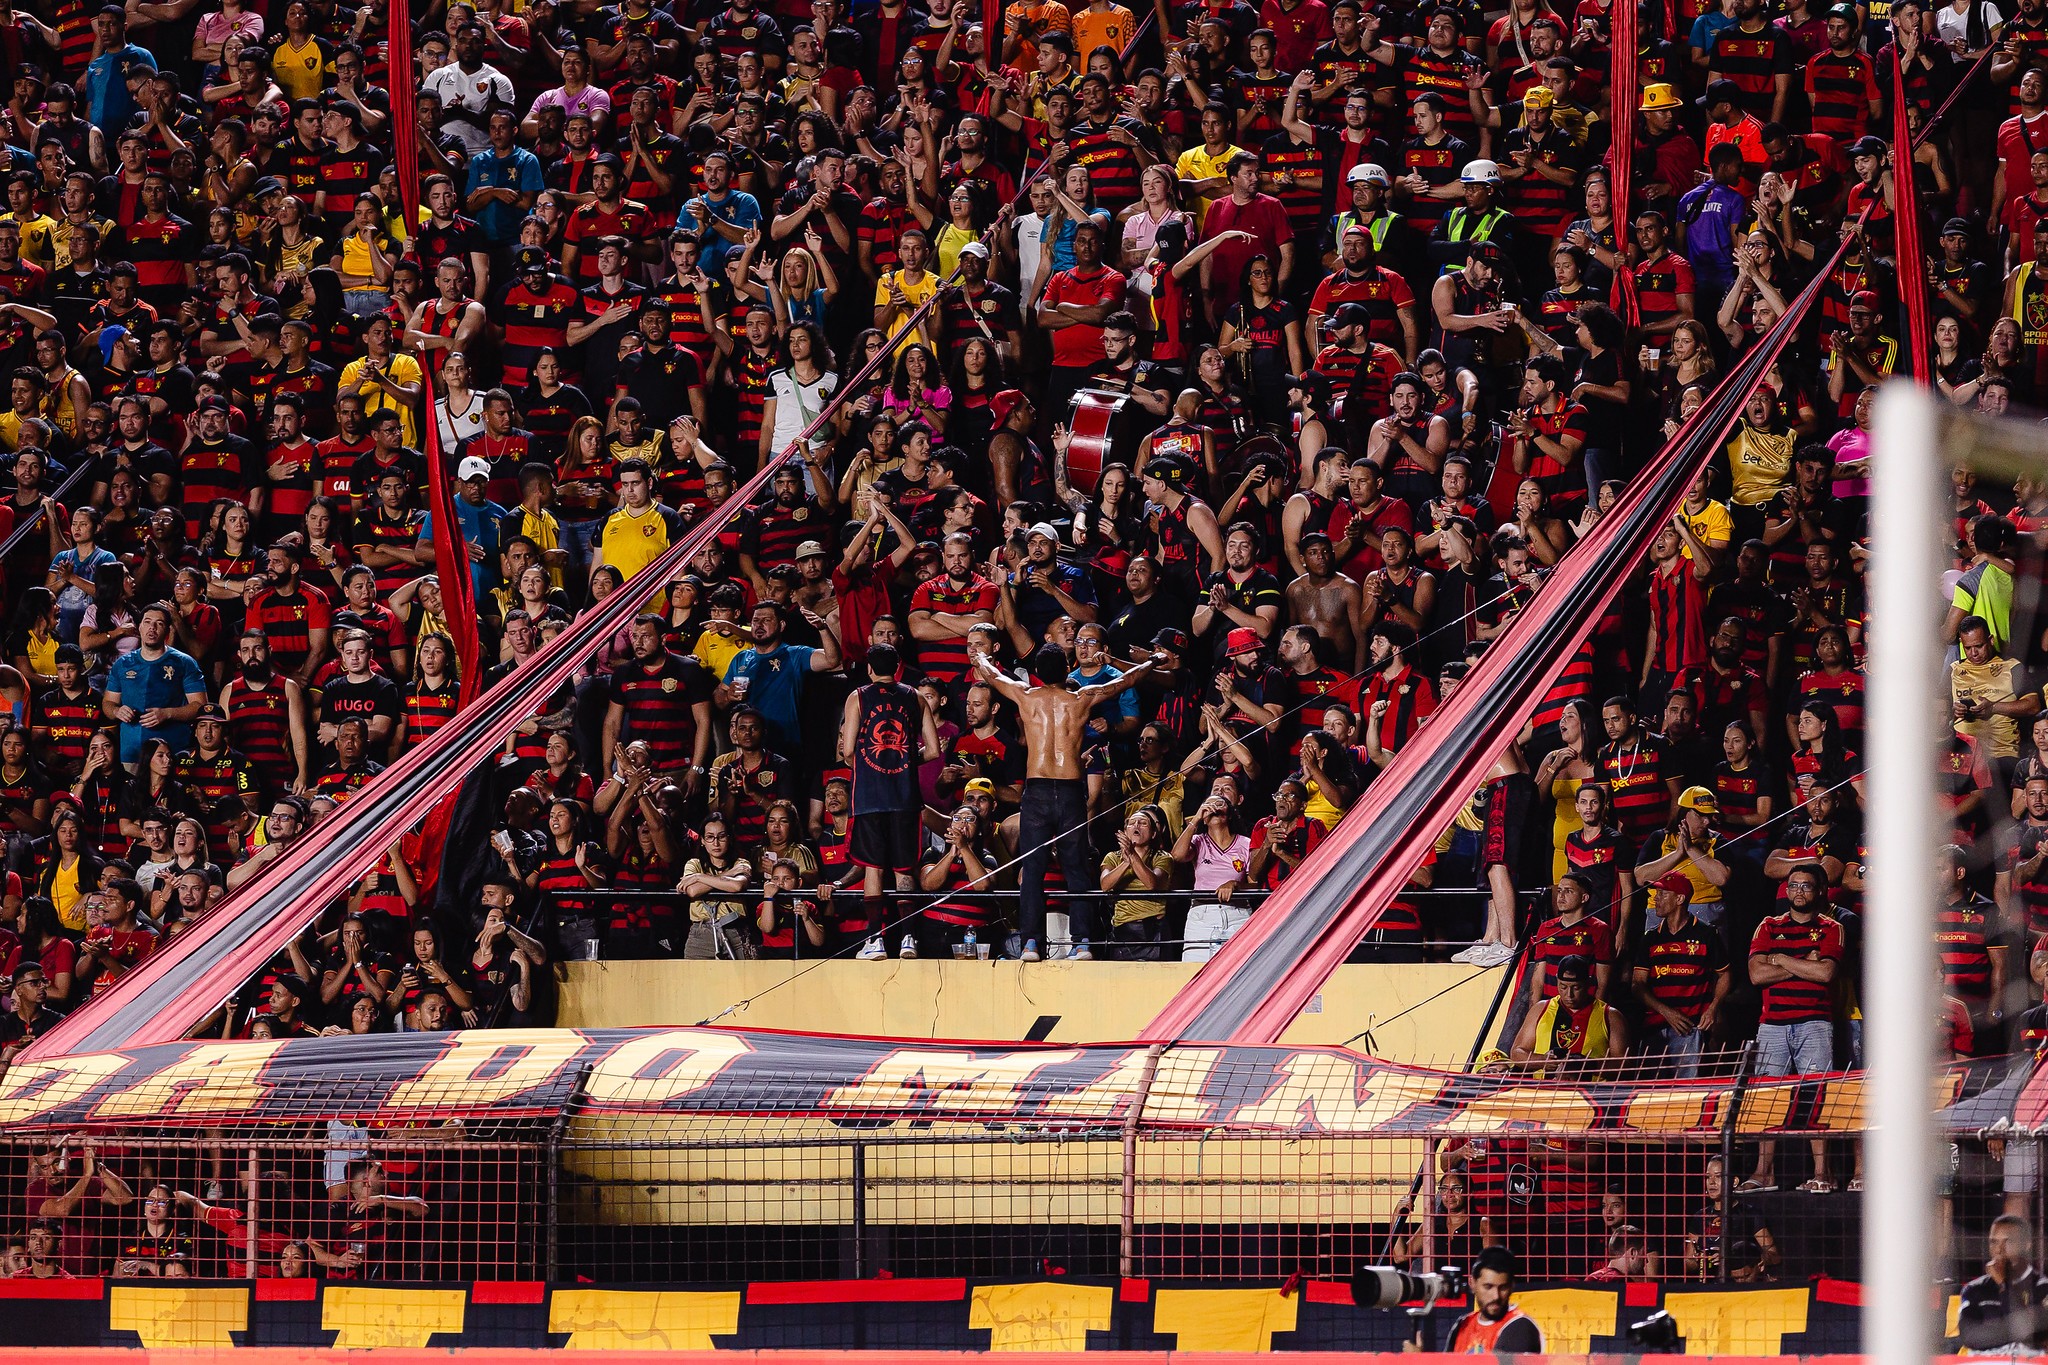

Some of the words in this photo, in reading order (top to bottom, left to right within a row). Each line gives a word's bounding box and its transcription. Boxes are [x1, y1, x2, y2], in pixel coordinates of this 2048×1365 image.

[2024, 338, 2048, 346] RECIF
[333, 480, 351, 491] CAI
[334, 700, 375, 712] HUGO
[388, 1028, 755, 1110] DO
